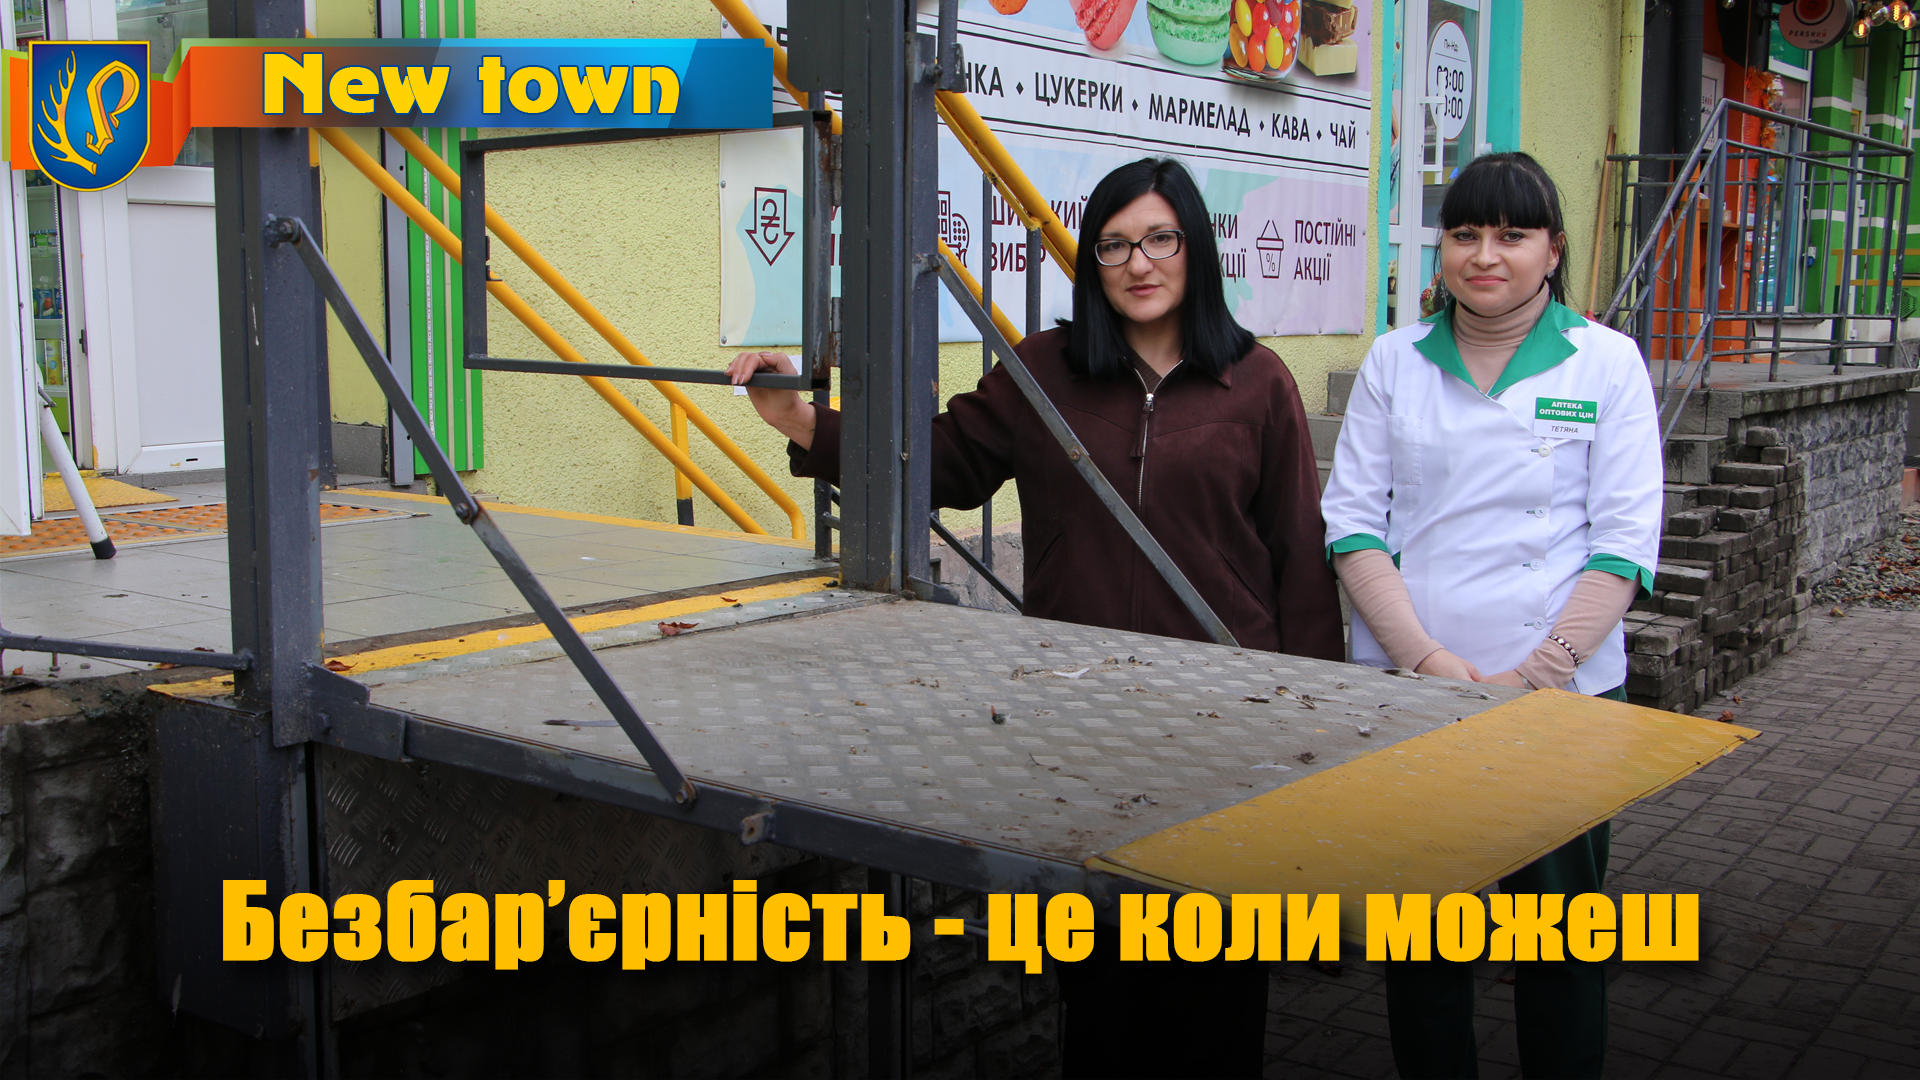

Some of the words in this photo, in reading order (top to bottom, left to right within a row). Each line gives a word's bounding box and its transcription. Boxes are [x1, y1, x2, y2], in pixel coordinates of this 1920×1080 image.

[1034, 71, 1124, 114] ЦУКЕРКИ
[1148, 93, 1251, 138] МАРМЕЛАД
[1271, 112, 1311, 143] КАВА
[1329, 120, 1357, 149] ЧАЙ
[1294, 217, 1356, 247] ПОСТІЙНІ
[1293, 252, 1332, 285] АКЦІЇ
[1539, 408, 1577, 417] ОПТОВИХ
[1578, 411, 1594, 419] ЦІН
[1551, 401, 1583, 410] АПТЕКА
[1550, 425, 1579, 434] ТЕТЯНА
